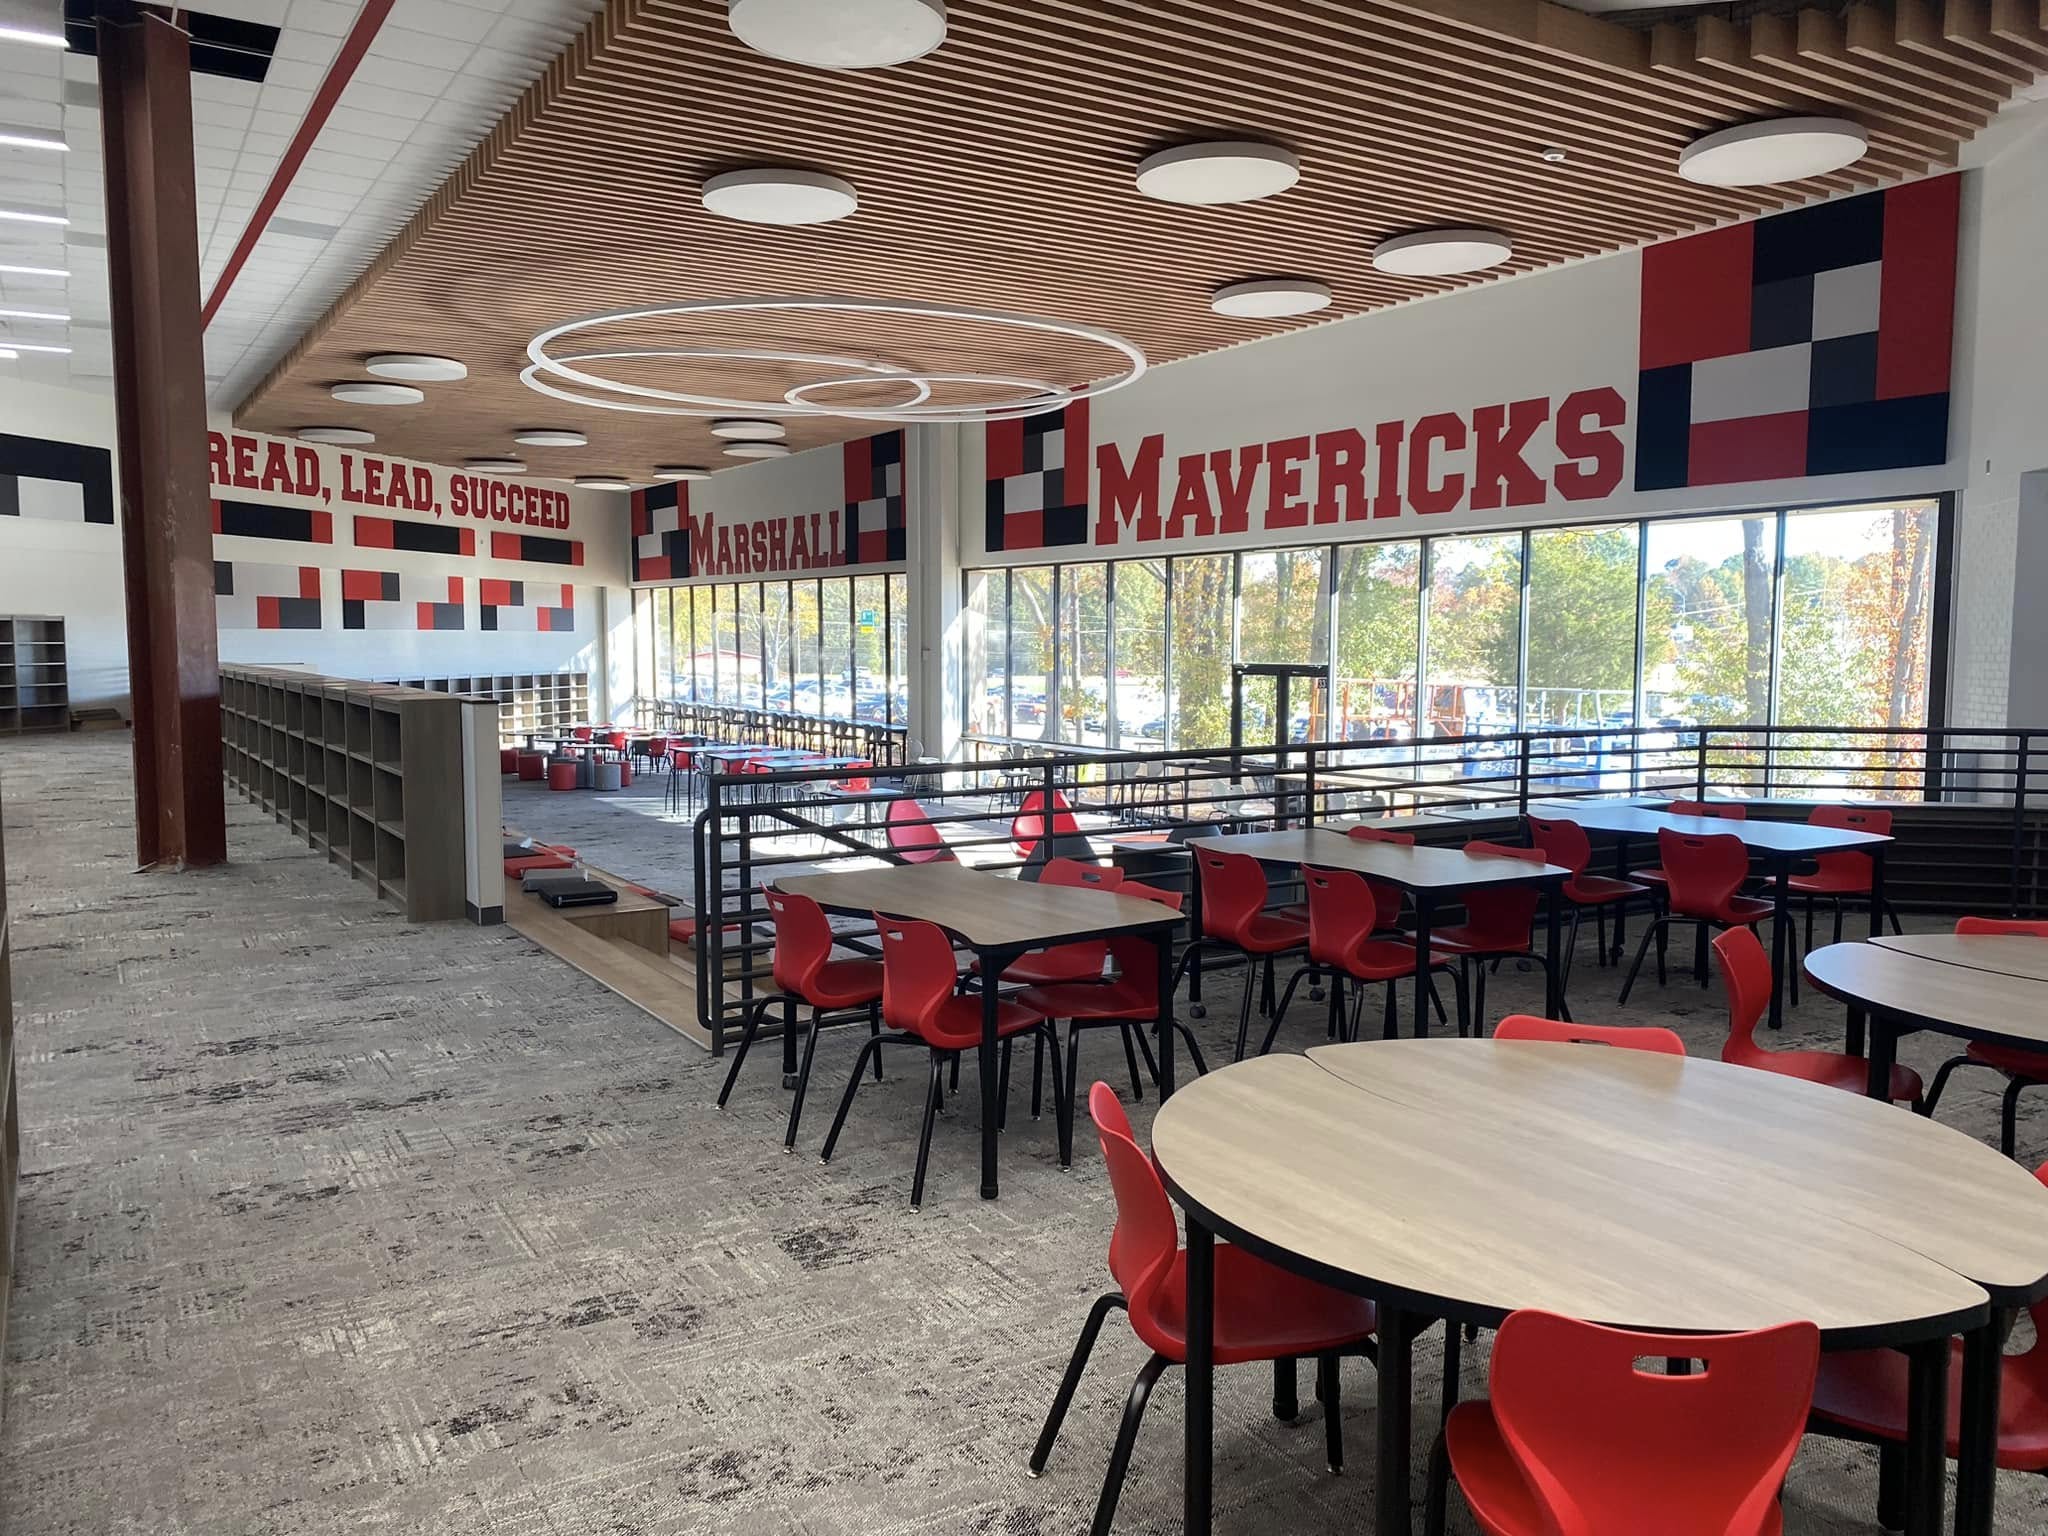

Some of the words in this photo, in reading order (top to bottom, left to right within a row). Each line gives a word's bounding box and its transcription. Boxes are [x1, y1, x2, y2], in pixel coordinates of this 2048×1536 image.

[207, 430, 331, 506] READ,
[341, 454, 443, 519] LEAD,
[449, 474, 571, 530] SUCCEED
[1095, 386, 1627, 546] MAVERICKS
[688, 510, 847, 577] MARSHALL
